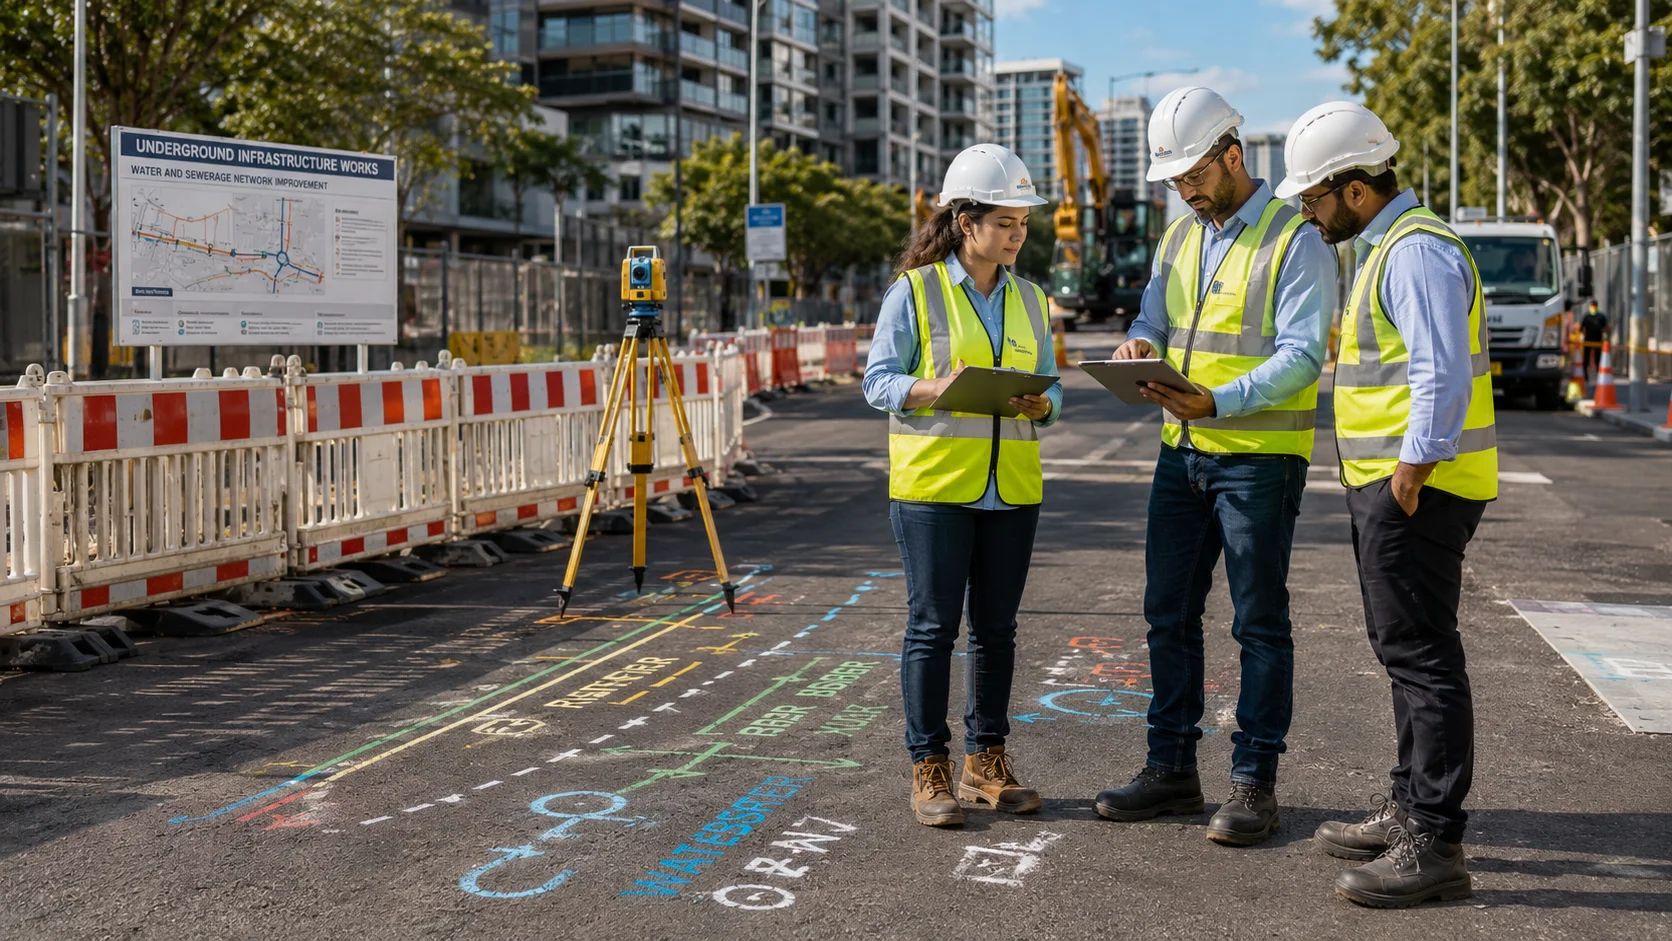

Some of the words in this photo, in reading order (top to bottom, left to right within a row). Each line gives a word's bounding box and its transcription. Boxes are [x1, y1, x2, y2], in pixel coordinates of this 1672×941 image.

[136, 139, 234, 161] UNDERGROUND
[238, 149, 338, 171] INFRASTRUCTURE
[340, 159, 378, 175] WORKS
[131, 165, 162, 176] WATER
[164, 168, 183, 178] AND
[185, 169, 231, 182] SEWERAGE
[234, 174, 272, 186] NETWORK
[275, 177, 328, 190] IMPROVEMENT
